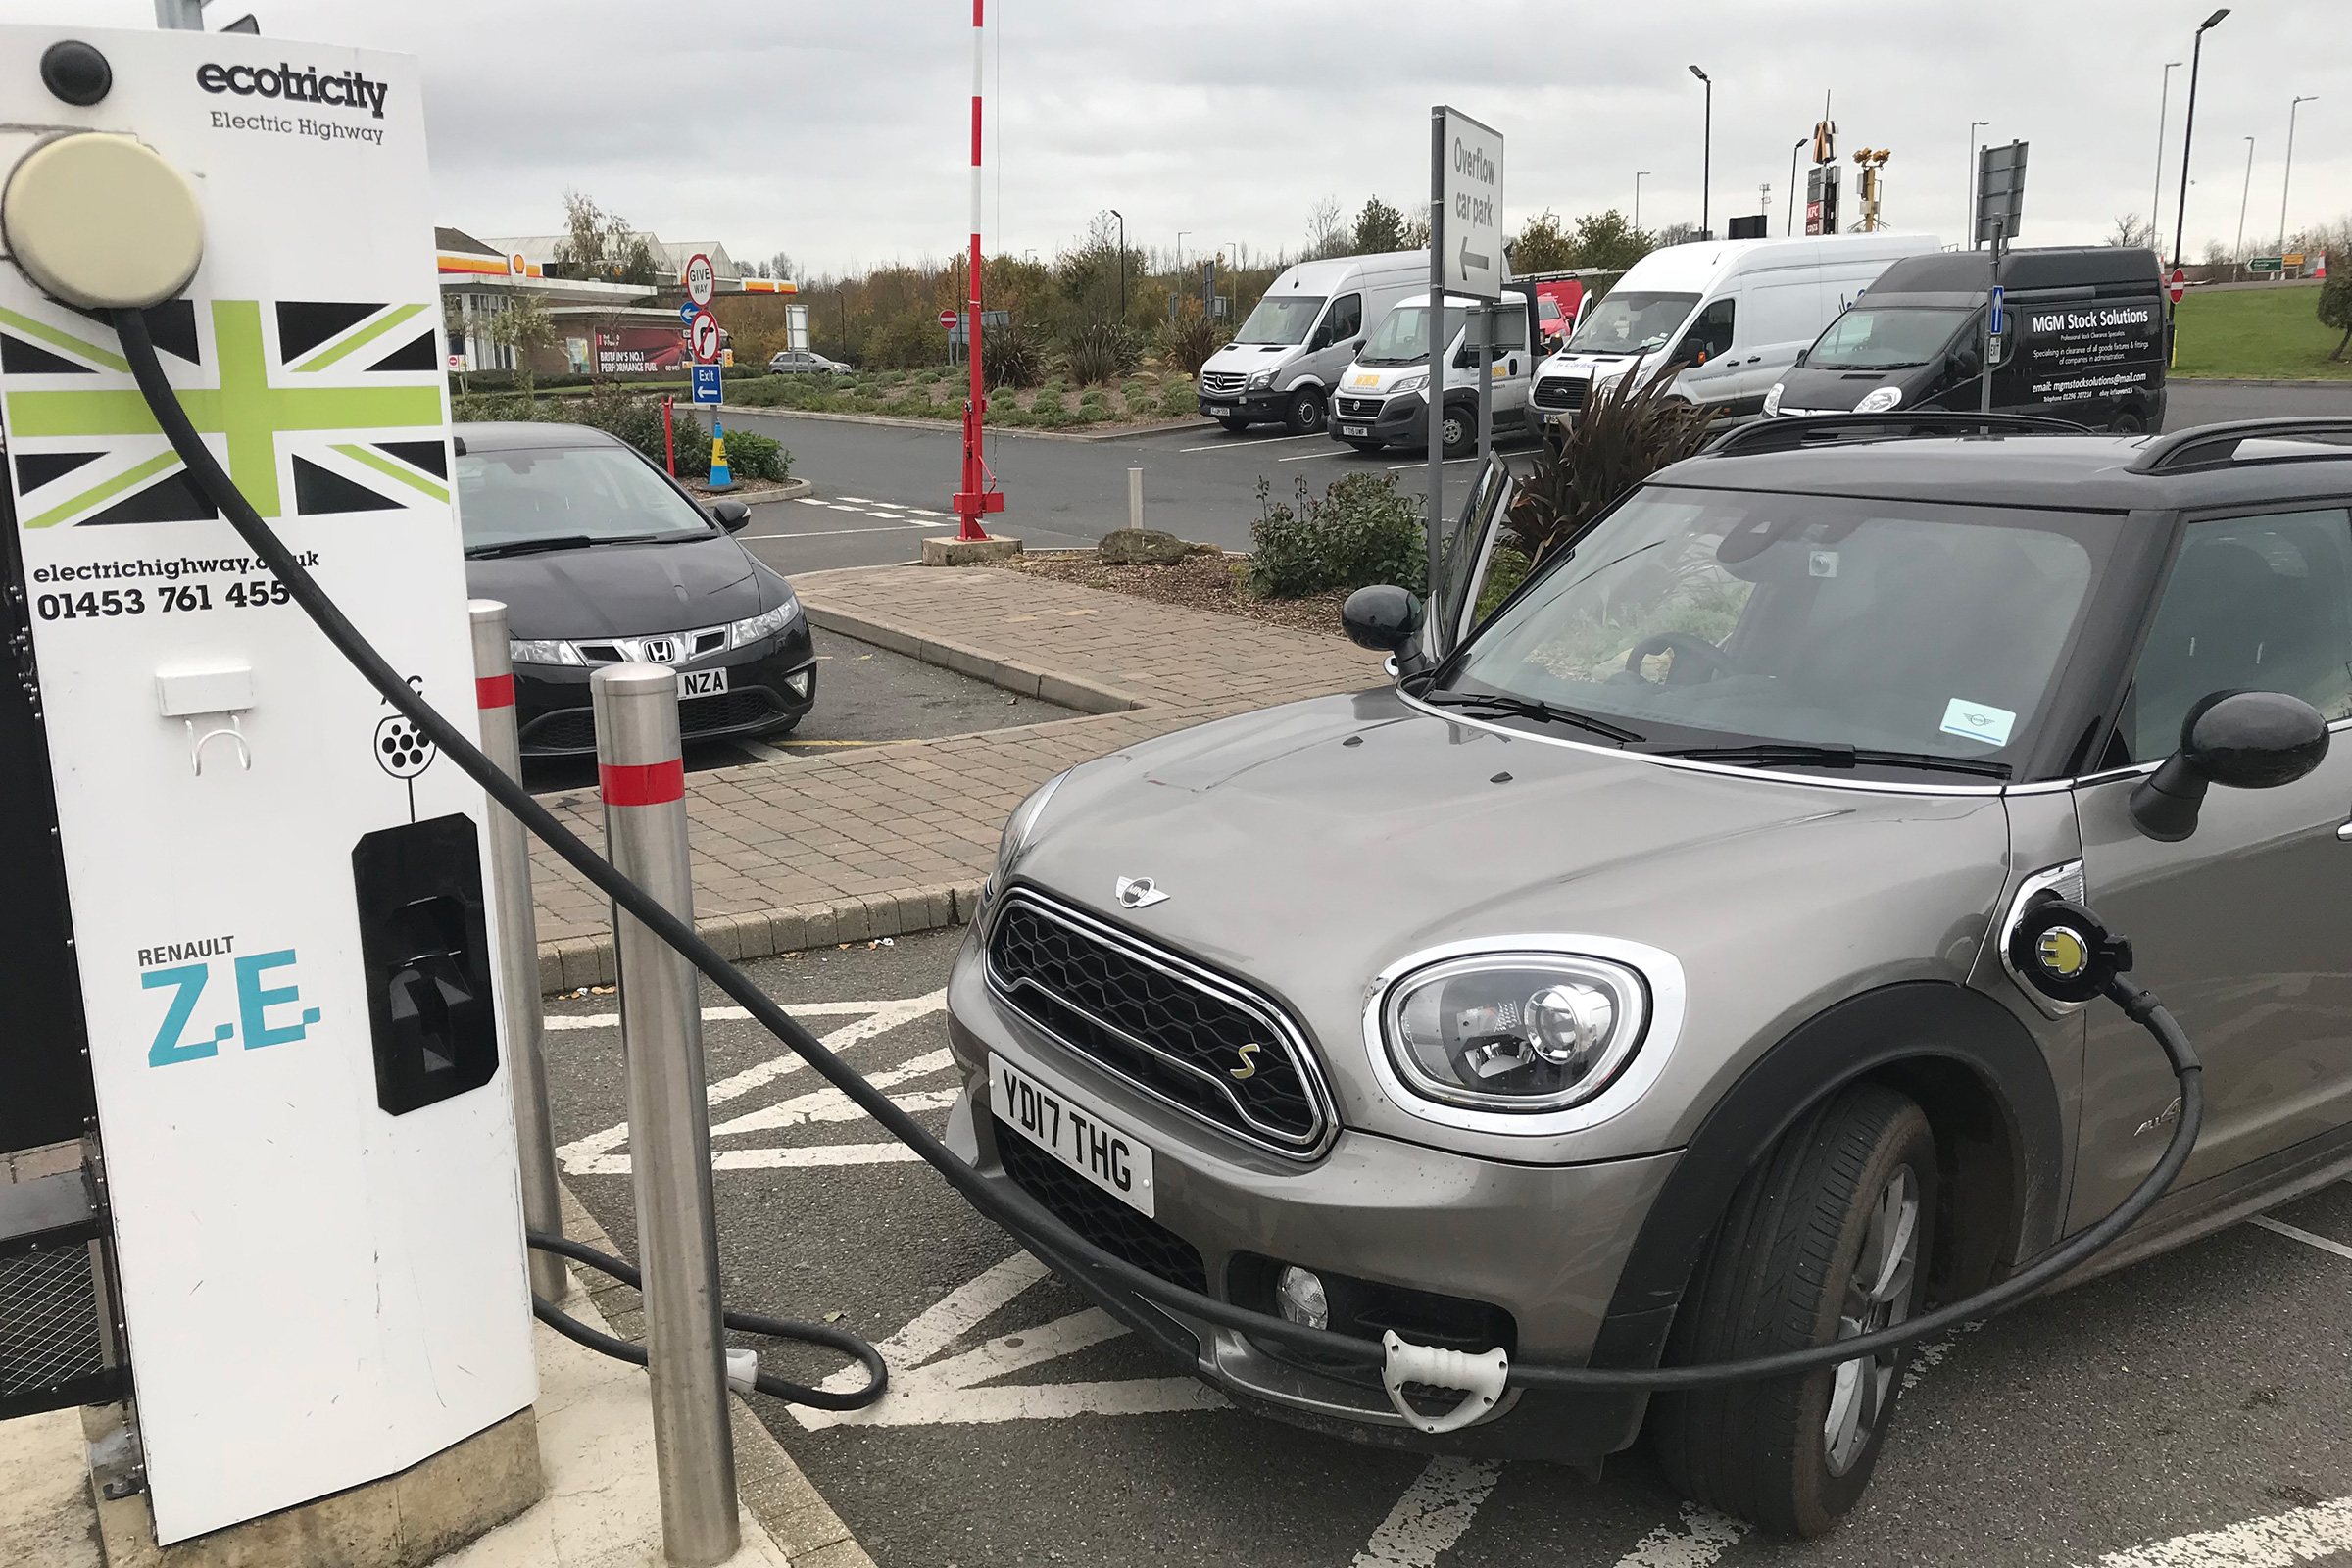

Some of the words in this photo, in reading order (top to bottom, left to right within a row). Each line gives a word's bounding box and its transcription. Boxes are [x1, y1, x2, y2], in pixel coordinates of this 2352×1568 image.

[196, 62, 388, 119] ecotricity
[210, 111, 292, 133] Electric
[298, 119, 383, 145] Highway
[1454, 136, 1495, 186] Overflow
[1455, 192, 1471, 220] car
[1473, 194, 1493, 228] park
[1807, 205, 1819, 219] KFC
[689, 268, 710, 282] GIVE
[693, 283, 709, 295] WAY
[2033, 315, 2064, 332] MGM
[2068, 312, 2097, 329] Stock
[2100, 308, 2148, 326] Solutions
[629, 351, 644, 362] NO.1
[2033, 348, 2059, 360] Specialising
[2065, 346, 2086, 355] clearance
[2086, 344, 2092, 353] of
[2098, 343, 2113, 354] goods
[2113, 342, 2130, 351] fixtures
[2134, 340, 2149, 350] fittings
[2059, 356, 2065, 365] of
[2065, 355, 2088, 366] companies
[644, 362, 658, 372] FUEL
[698, 369, 714, 382] Exit
[2032, 381, 2052, 393] email:
[2052, 372, 2146, 392] mgmstocksolutions@mail.com
[33, 551, 319, 582] electrichighway.cuk
[37, 588, 146, 620] 01453
[158, 584, 212, 612] 761
[225, 579, 291, 608] 455
[684, 671, 724, 695] NZA
[1127, 884, 1148, 899] MINI
[138, 935, 234, 966] RENAULT
[1230, 1043, 1261, 1079] S
[1003, 1068, 1060, 1148] YD17
[1069, 1110, 1132, 1192] THG
